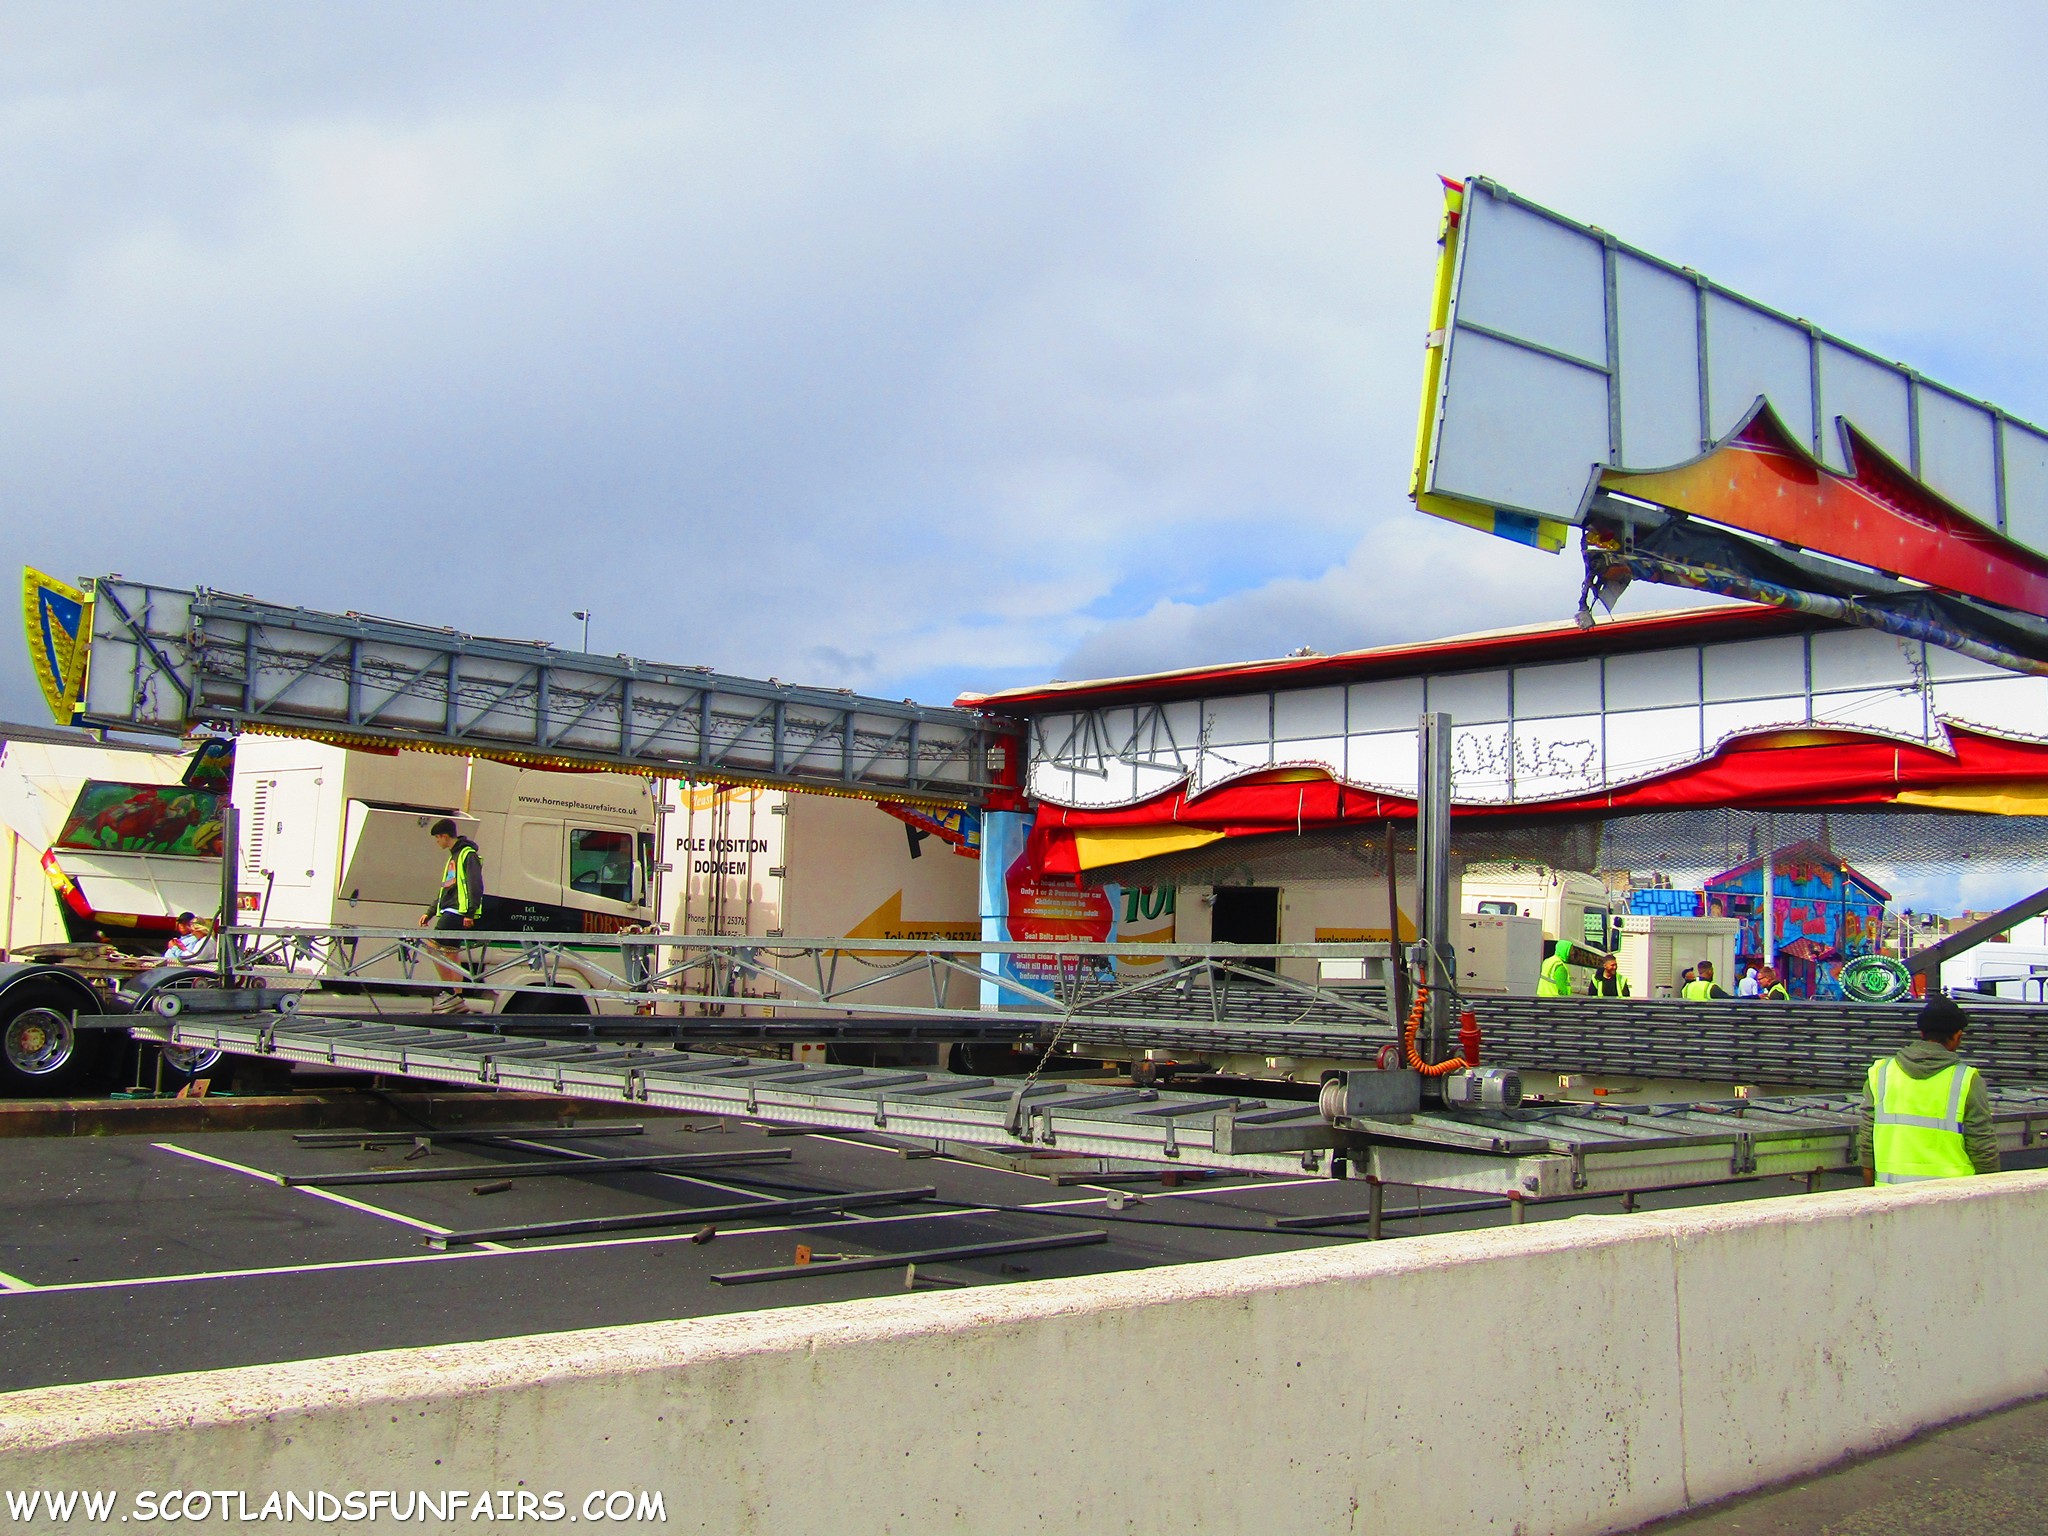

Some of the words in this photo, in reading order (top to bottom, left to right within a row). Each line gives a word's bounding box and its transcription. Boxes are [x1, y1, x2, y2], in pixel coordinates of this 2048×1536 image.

[518, 795, 638, 815] www.hornespleasurefairs.co.uk
[676, 838, 705, 852] POLE
[709, 838, 768, 853] POSITION
[694, 860, 747, 875] DODGEM
[1020, 887, 1034, 896] Only
[1055, 889, 1078, 897] Persons
[1080, 891, 1090, 899] per
[1034, 898, 1060, 906] Children
[1062, 899, 1077, 907] must
[1078, 899, 1086, 907] be
[1023, 908, 1064, 916] accompanied
[1066, 908, 1073, 917] by
[1083, 909, 1099, 917] adult
[687, 913, 706, 923] Phone:
[1024, 932, 1038, 940] Seat
[1039, 933, 1053, 941] Belts
[1055, 933, 1069, 941] must
[1015, 962, 1030, 970] Wait
[1042, 963, 1052, 971] the
[1019, 972, 1039, 980] before
[1843, 970, 1909, 989] MATRIX
